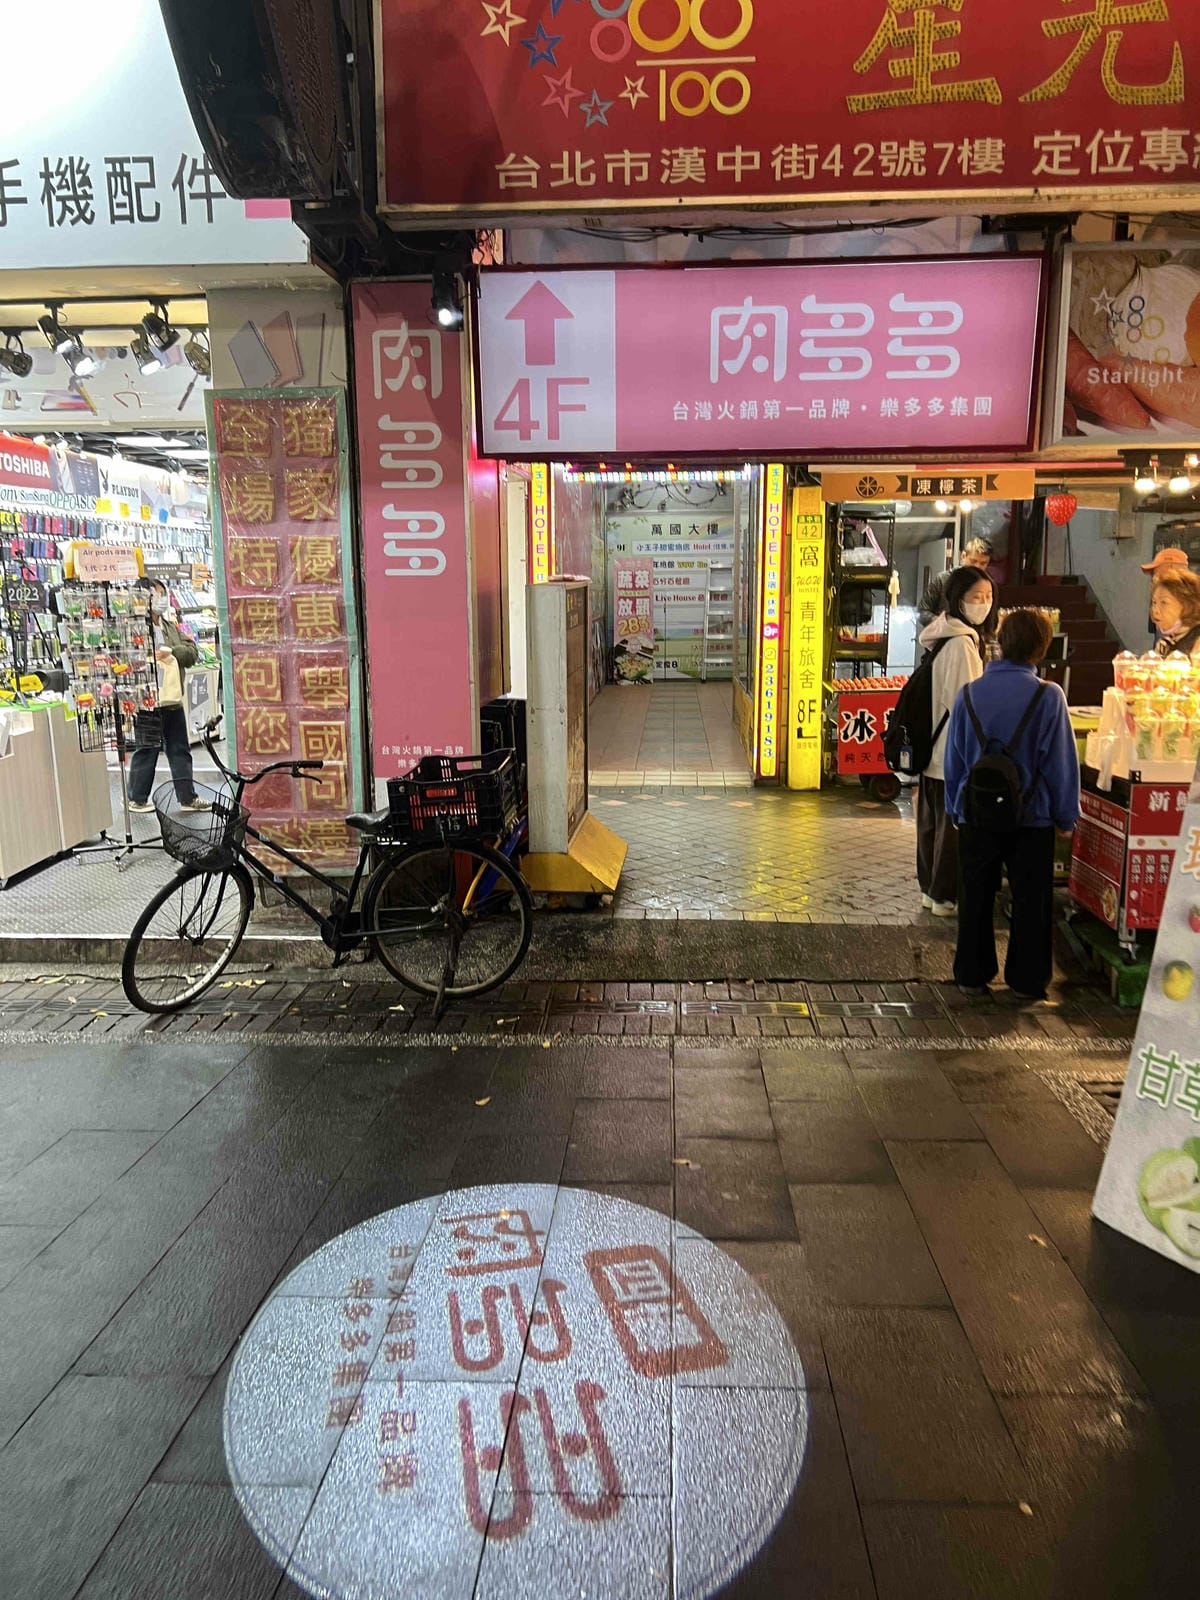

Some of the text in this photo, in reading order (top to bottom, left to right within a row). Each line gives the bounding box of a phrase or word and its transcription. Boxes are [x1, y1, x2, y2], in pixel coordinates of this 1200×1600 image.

[495, 126, 1200, 190] 台北市漢中街42號7樓 定位專
[709, 292, 964, 384] 肉多多
[1087, 366, 1184, 388] Starlight
[493, 376, 590, 442] 4F
[372, 320, 447, 577] 肉多多
[111, 484, 140, 498] PLAYBOY
[916, 478, 977, 495] 凍檸茶
[534, 505, 545, 568] HOTEL
[651, 523, 719, 536] 萬國大樓
[768, 502, 780, 567] HOTEL
[801, 525, 818, 538] 42
[800, 545, 819, 568] 窩
[8, 588, 40, 602] 2023
[655, 594, 672, 602] Live
[673, 594, 696, 602] House
[799, 601, 817, 690] 青年旅舍
[764, 663, 774, 759] 23619183
[797, 699, 817, 724] 8F
